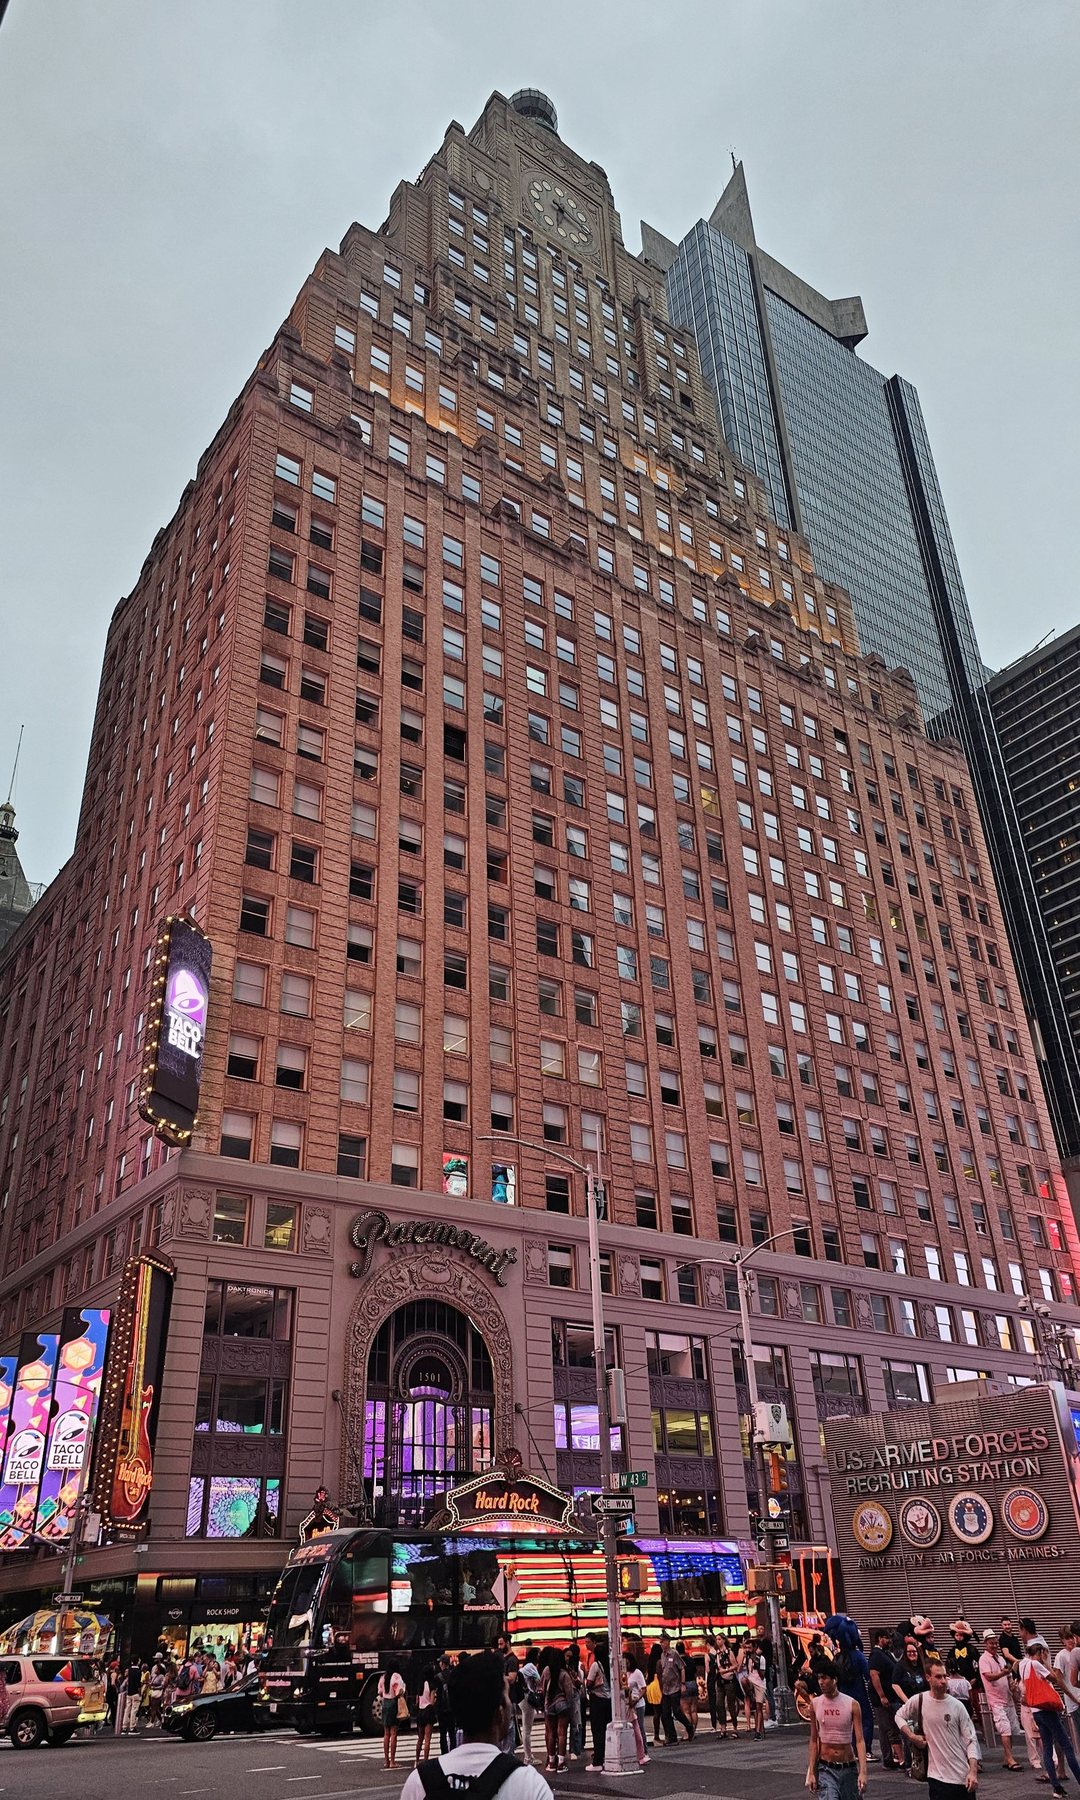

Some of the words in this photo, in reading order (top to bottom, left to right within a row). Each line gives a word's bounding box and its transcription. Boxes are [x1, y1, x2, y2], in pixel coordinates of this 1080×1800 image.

[168, 1011, 201, 1043] TACO
[168, 1028, 200, 1059] BELL
[350, 1210, 517, 1287] Paramount
[419, 1372, 441, 1383] 1501
[53, 1444, 84, 1454] TACO
[869, 1438, 950, 1468] ARMED
[951, 1427, 1049, 1458] FORCES
[10, 1461, 39, 1470] TACO
[52, 1454, 82, 1465] BELL
[9, 1470, 36, 1480] BELL
[118, 1462, 137, 1483] Hard
[621, 1474, 628, 1486] W
[630, 1473, 639, 1485] 43
[846, 1466, 954, 1494] RECRUITING
[957, 1456, 1041, 1483] STATION
[475, 1491, 508, 1509] Hard
[508, 1492, 540, 1514] Rock
[597, 1499, 610, 1508] ONE
[615, 1500, 630, 1508] WAY
[857, 1556, 885, 1568] ARMY
[893, 1553, 924, 1566] NVY
[960, 1549, 998, 1561] FORCE
[1007, 1545, 1059, 1559] MARINES
[206, 1608, 222, 1616] ROCK
[223, 1608, 240, 1616] SHOP
